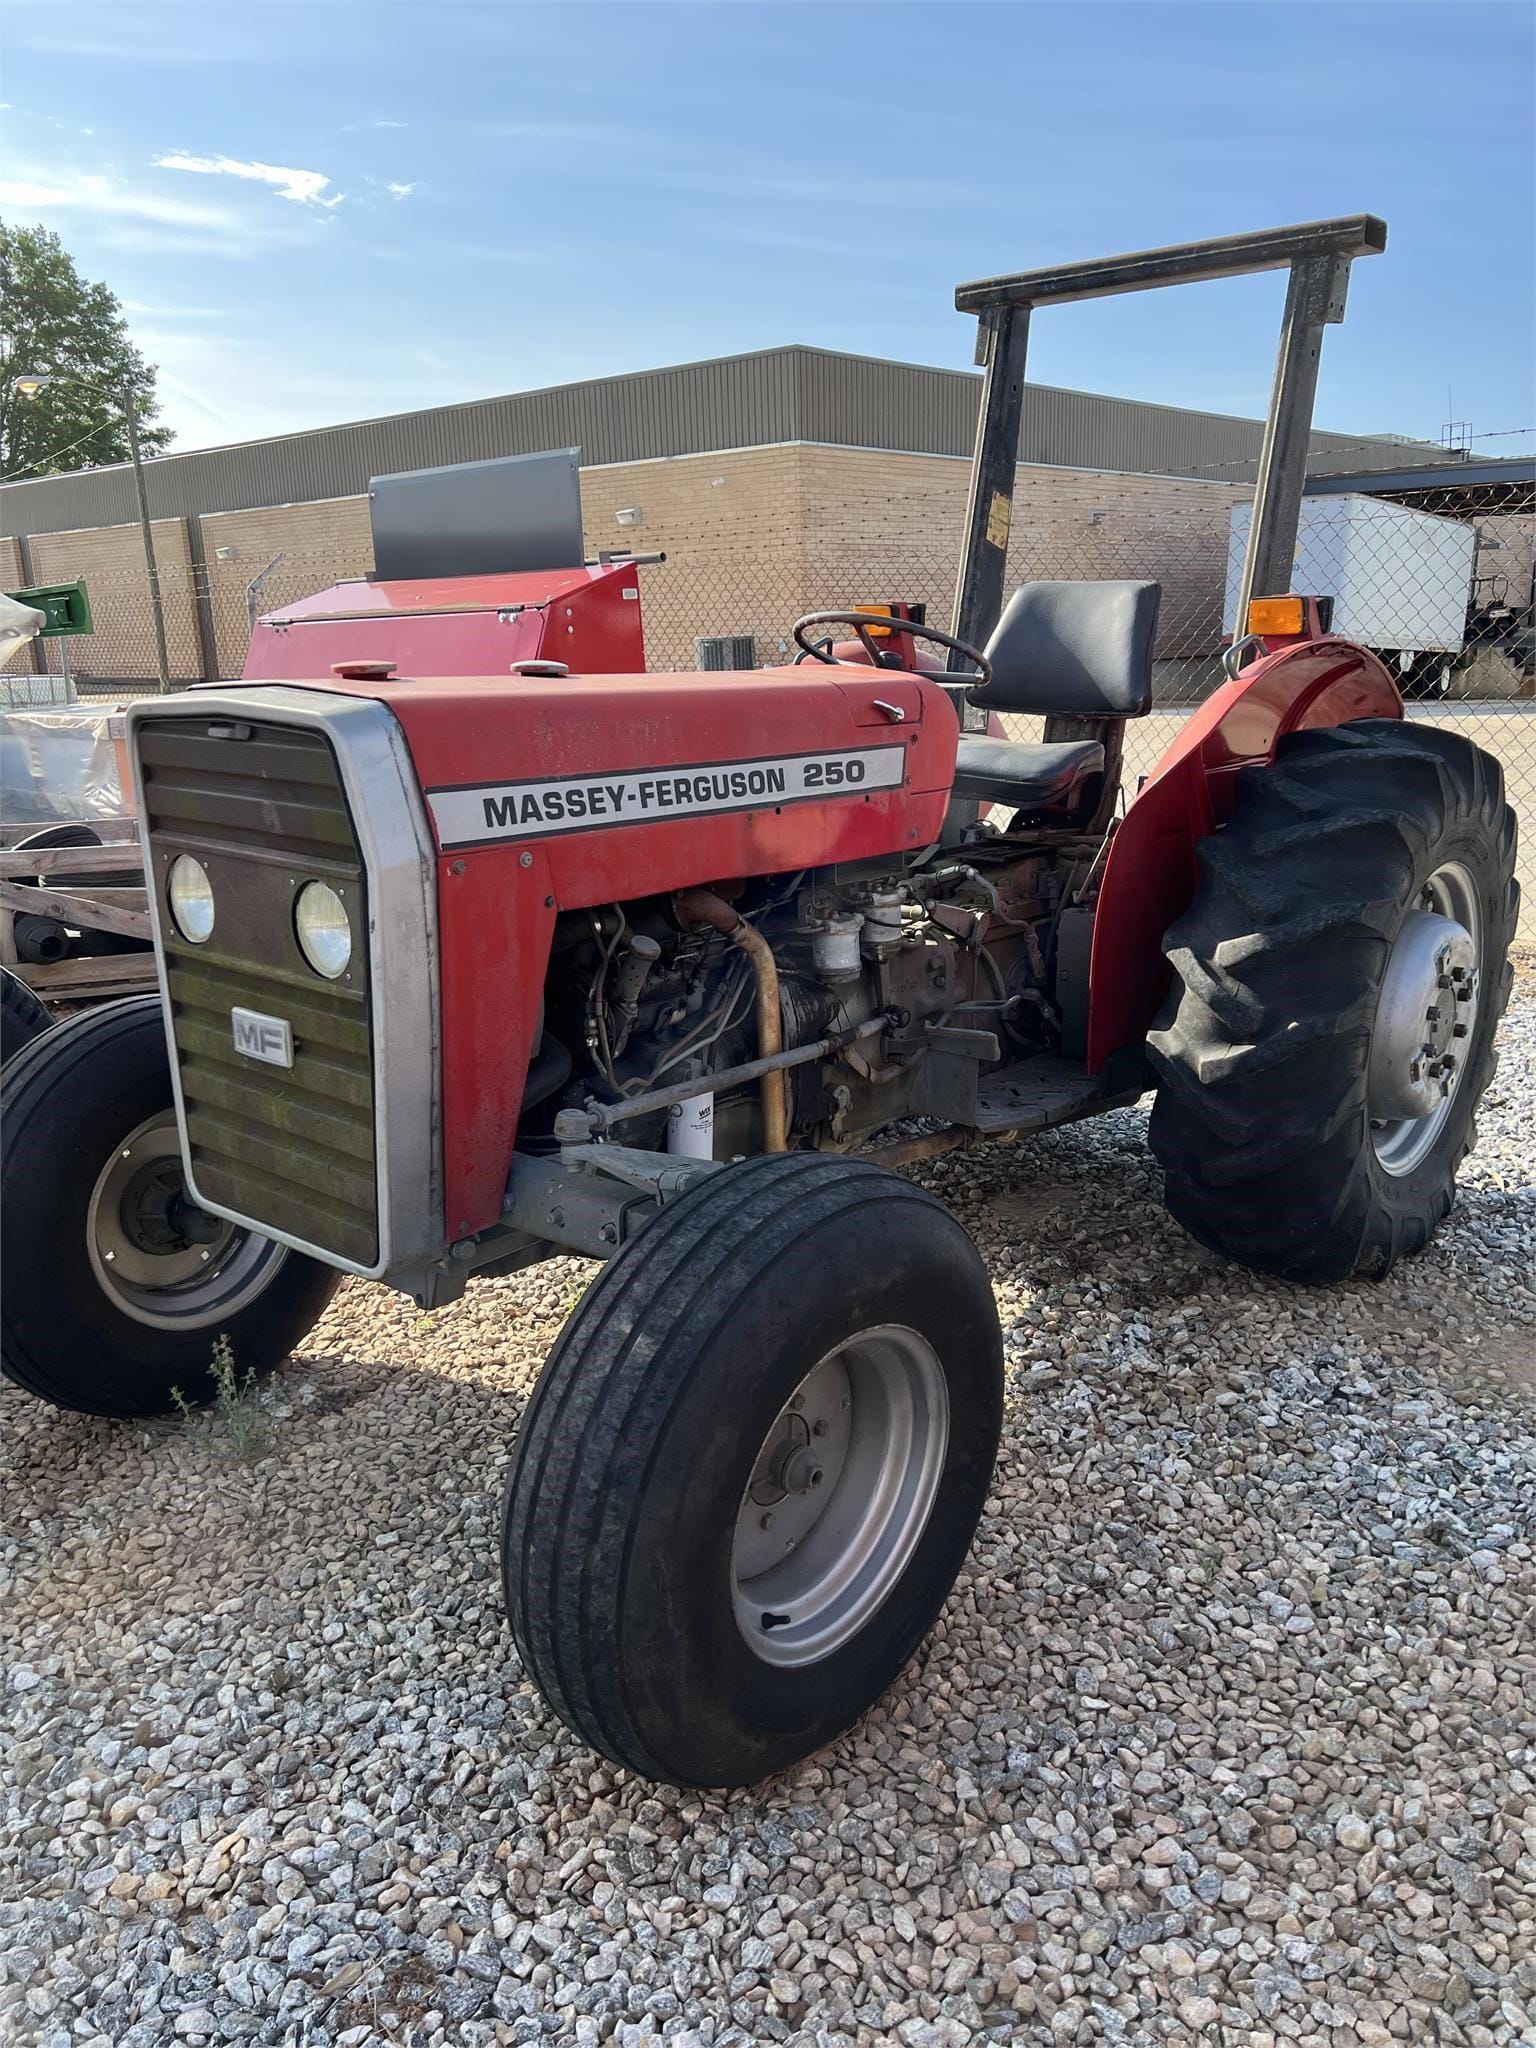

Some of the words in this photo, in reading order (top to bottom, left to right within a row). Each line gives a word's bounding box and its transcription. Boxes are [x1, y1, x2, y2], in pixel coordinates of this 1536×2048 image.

[482, 767, 786, 829] MASSEY-FERGUSON
[803, 759, 865, 787] 250
[236, 1021, 283, 1055] MF
